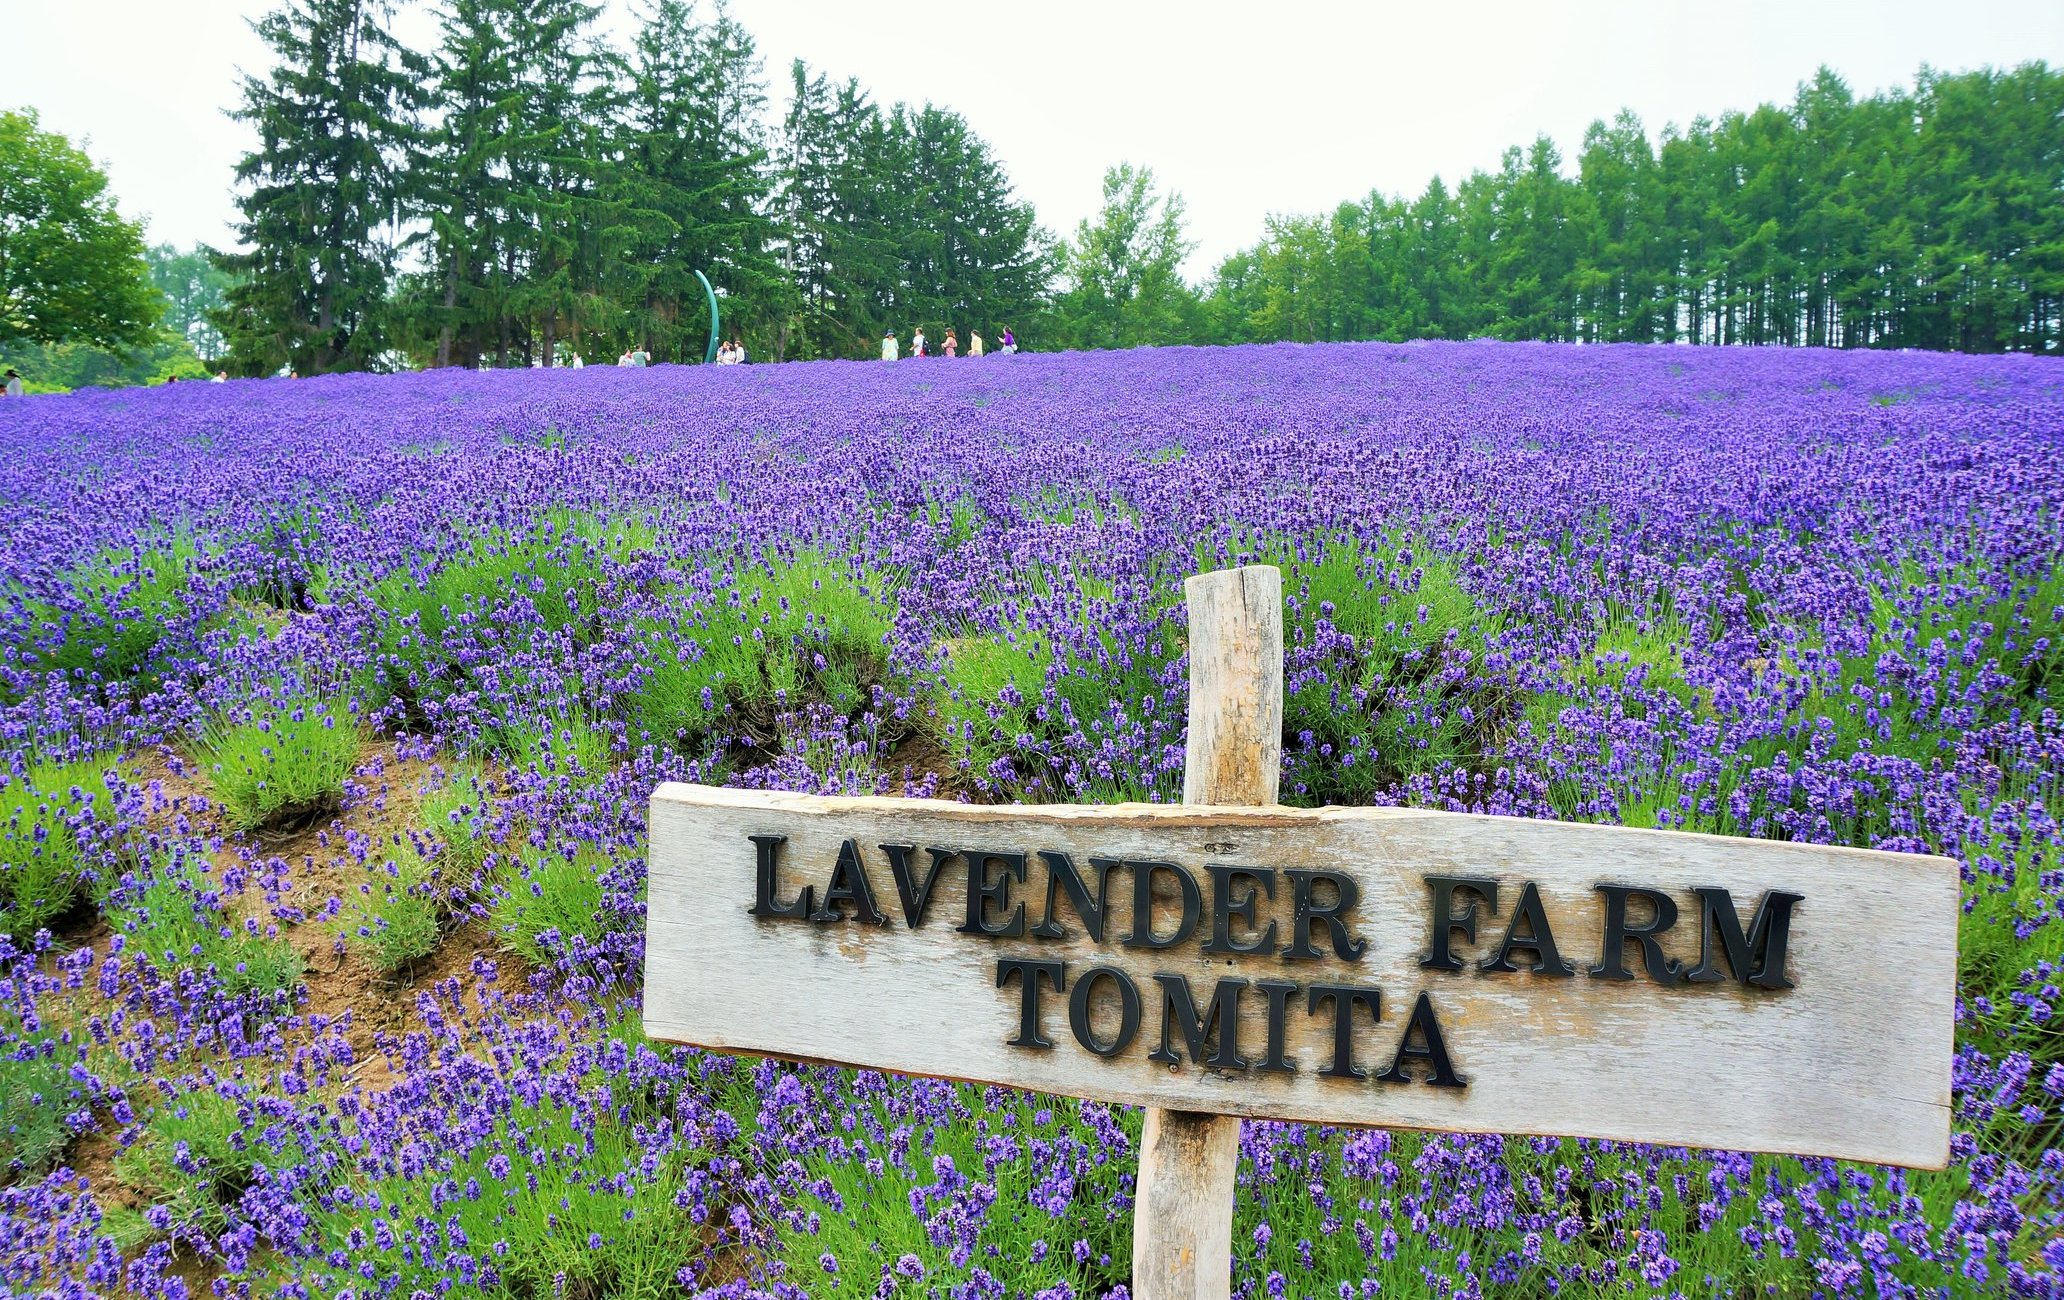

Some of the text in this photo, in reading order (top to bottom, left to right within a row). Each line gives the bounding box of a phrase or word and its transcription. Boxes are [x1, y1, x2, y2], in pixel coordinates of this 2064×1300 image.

[747, 835, 1805, 989] LAVENDER FARM
[996, 959, 1468, 1088] TOMITA
